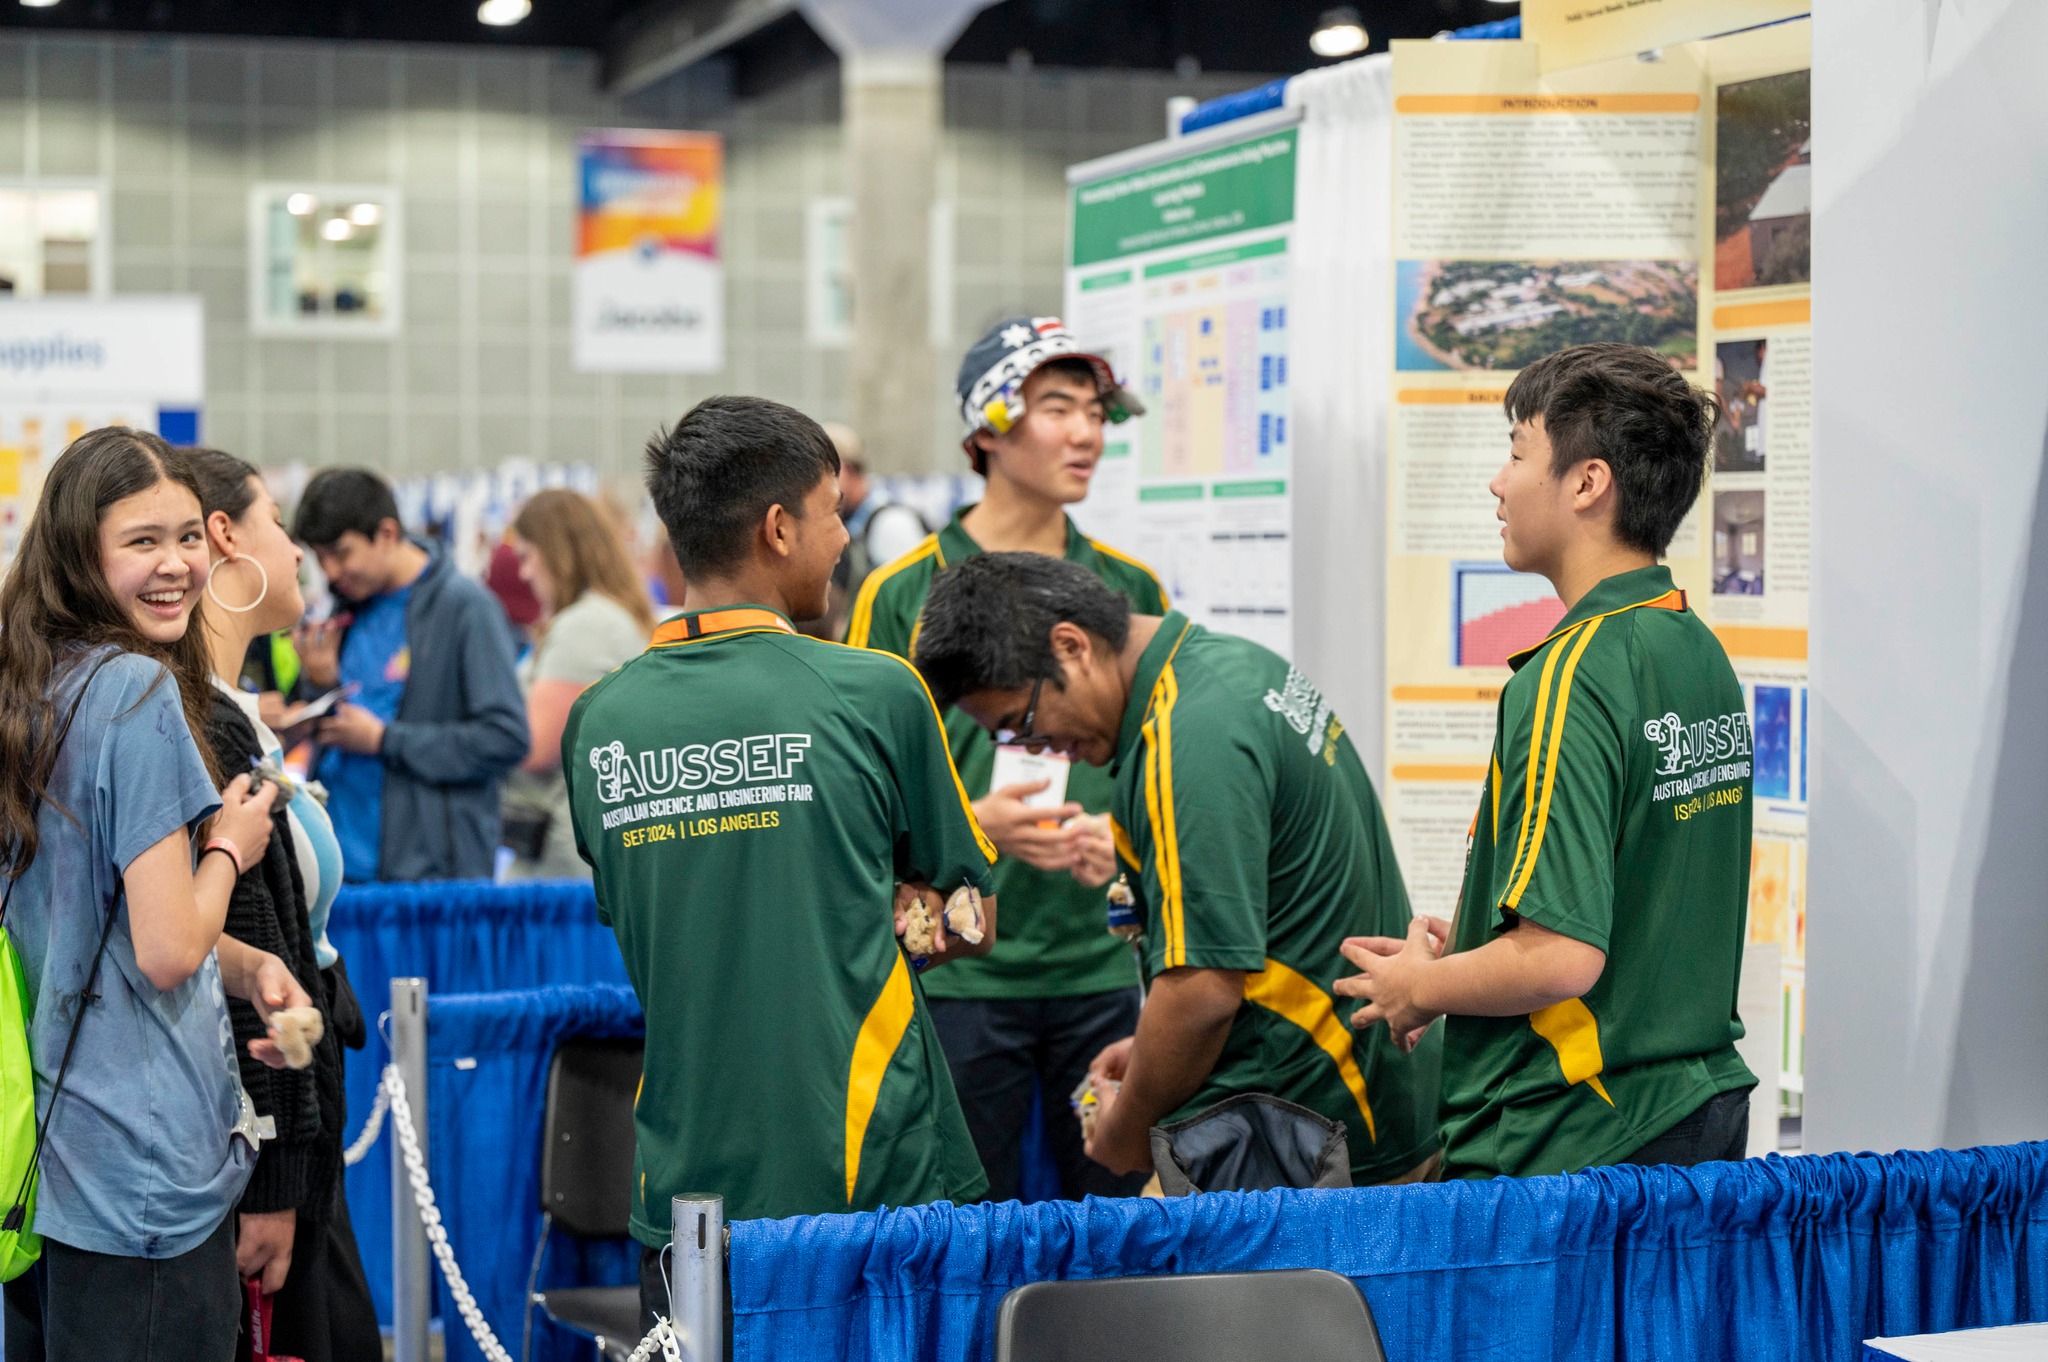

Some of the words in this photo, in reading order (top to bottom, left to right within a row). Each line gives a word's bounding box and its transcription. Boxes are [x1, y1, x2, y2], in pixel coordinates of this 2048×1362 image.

[618, 734, 811, 802] AUSSEF
[602, 801, 649, 831] AUSTRALIAN
[649, 795, 694, 818] SCIENCE
[696, 791, 719, 812] AND
[719, 785, 787, 809] ENGINEERING
[787, 783, 813, 802] FAIR
[646, 823, 676, 843] 2024
[689, 817, 718, 837] LOS
[720, 810, 781, 832] ANGELES
